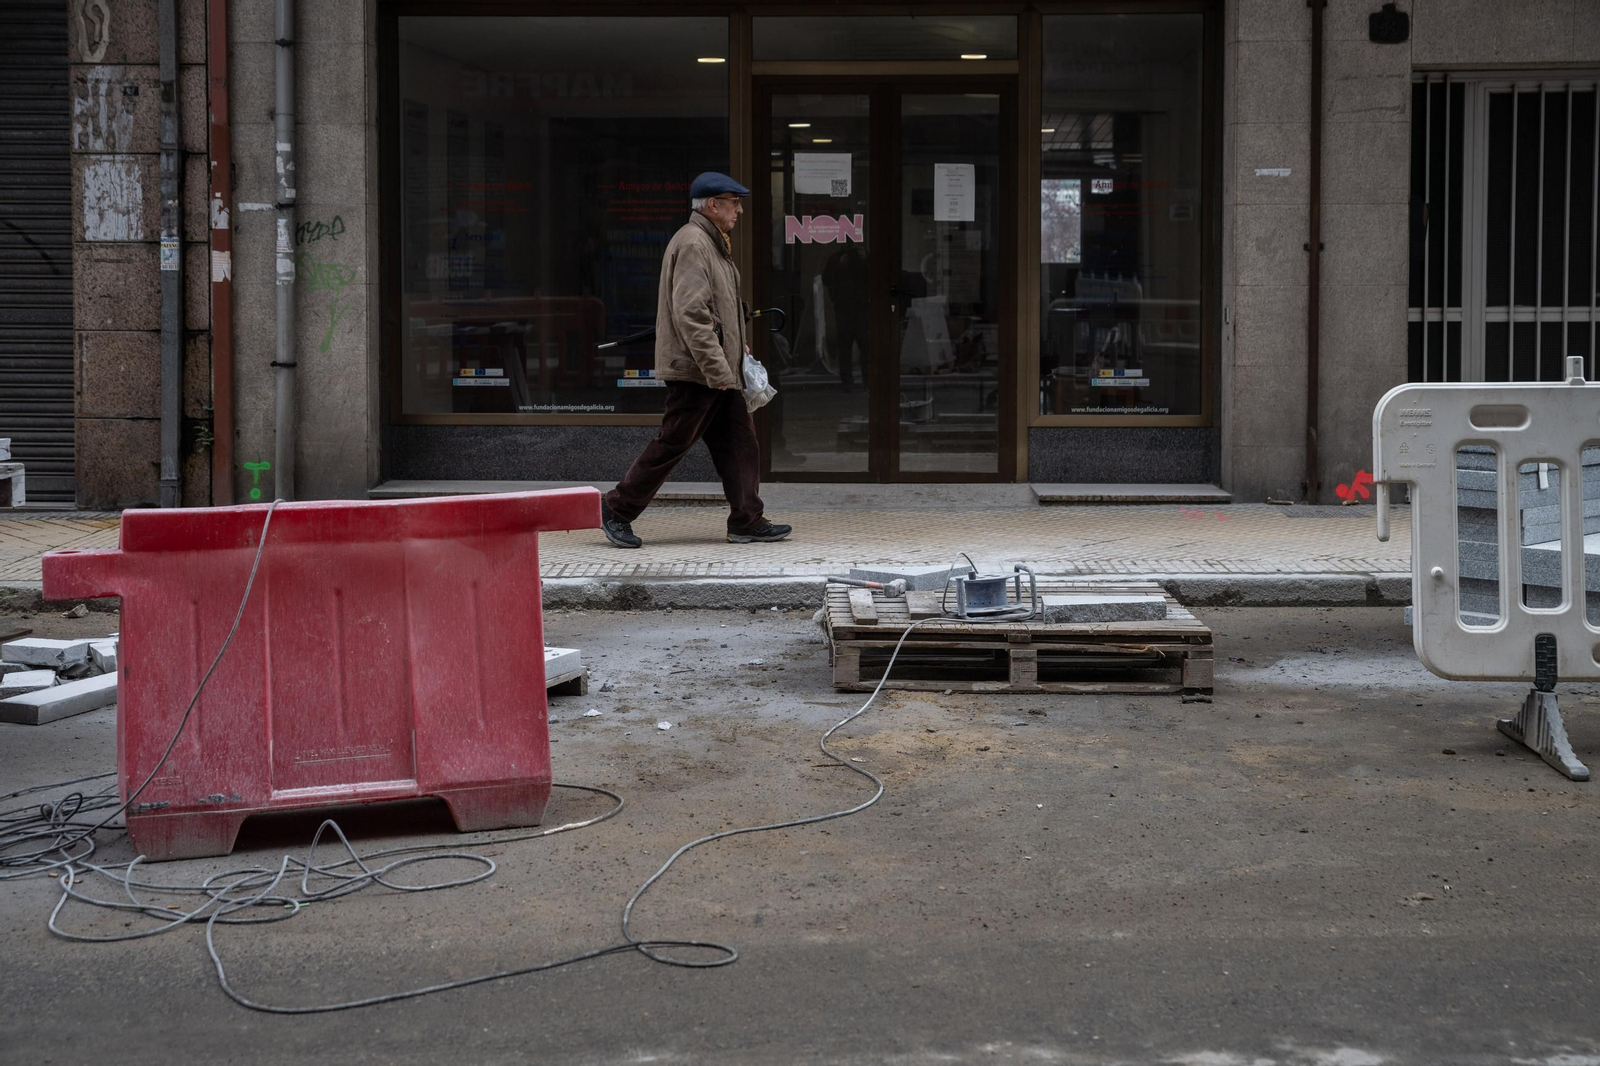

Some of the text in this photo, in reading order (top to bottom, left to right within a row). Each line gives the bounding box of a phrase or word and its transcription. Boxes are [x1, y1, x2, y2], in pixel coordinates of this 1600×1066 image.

[619, 180, 650, 192] Amigos
[652, 180, 663, 190] de
[785, 214, 864, 244] NON
[518, 403, 615, 412] www.fundacionamigosdegalicia.org
[1070, 405, 1169, 415] www.fundacionamigosdegalicia.org
